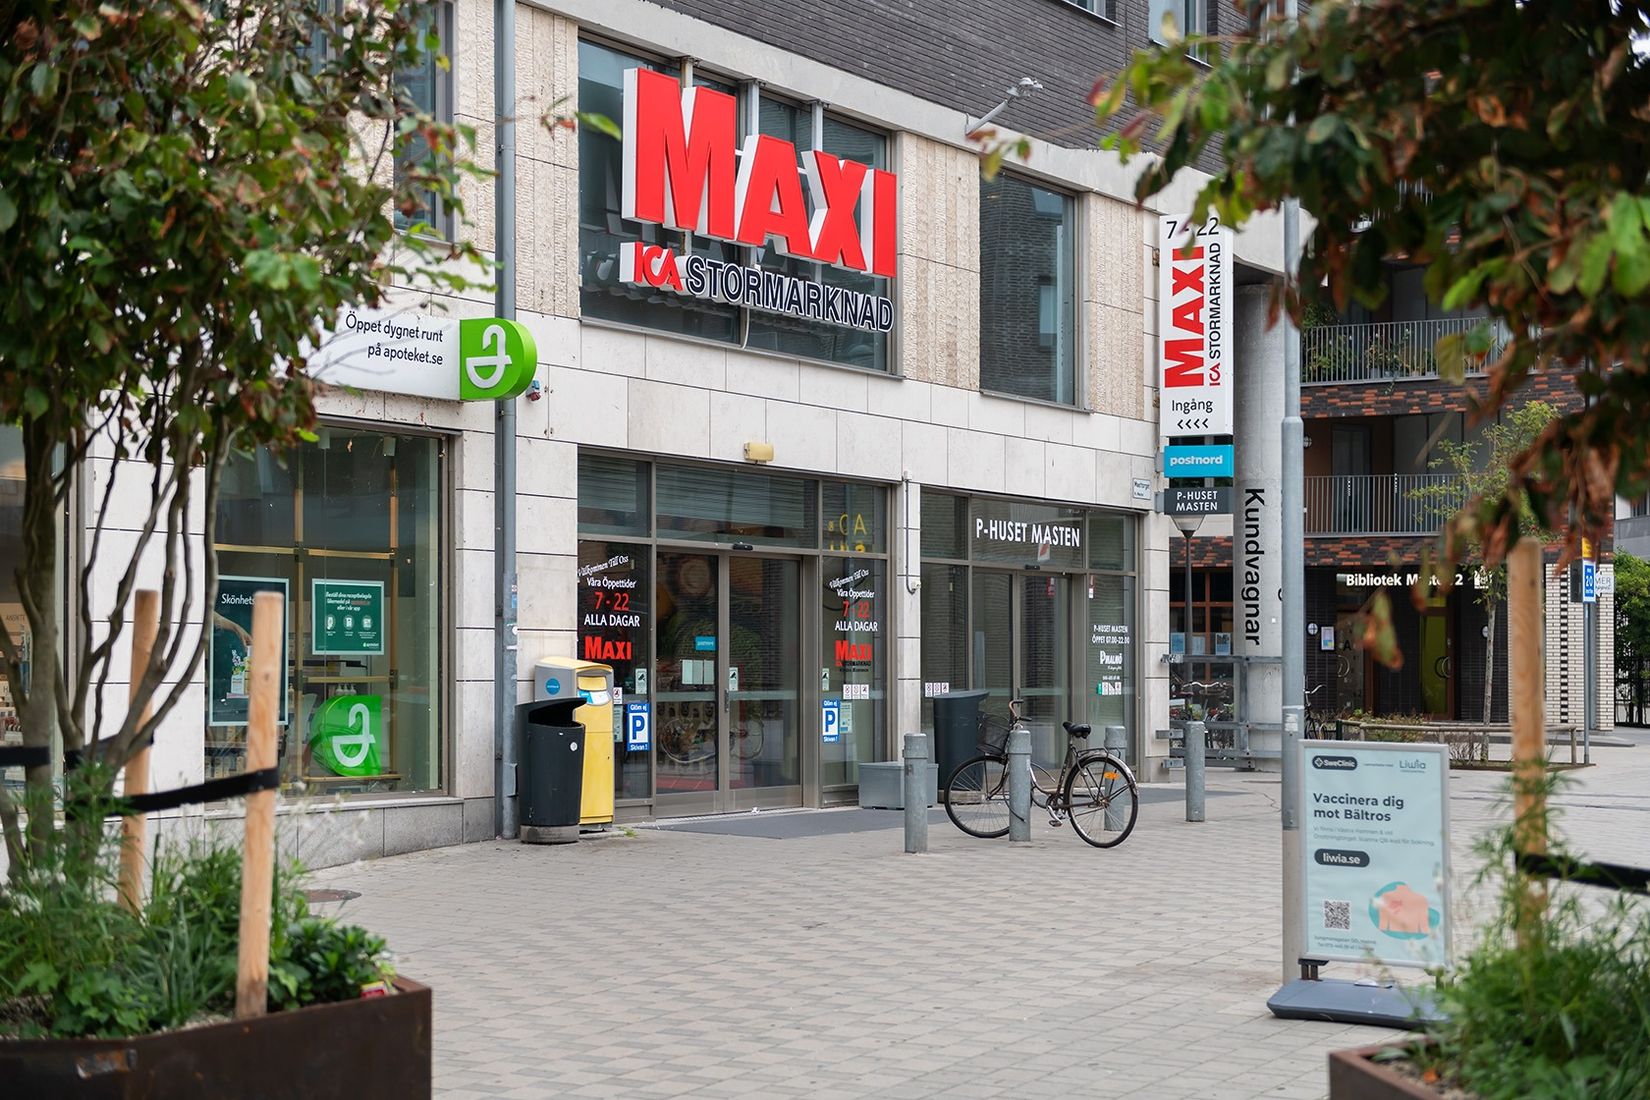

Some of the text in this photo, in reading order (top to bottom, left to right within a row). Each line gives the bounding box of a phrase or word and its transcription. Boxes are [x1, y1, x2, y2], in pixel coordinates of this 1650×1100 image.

[630, 66, 898, 279] MAXI
[630, 241, 894, 333] ICA STORMARKNAD
[1165, 246, 1204, 388] MAXI
[1209, 242, 1221, 386] ICA STORMARKNAD
[345, 310, 443, 342] Öppet dygnet runt
[368, 342, 443, 365] på apoteket.se
[1172, 398, 1213, 414] Ingång
[1170, 455, 1223, 466] postnord
[1176, 490, 1218, 500] P-HUSET
[1175, 502, 1218, 511] MASTEN
[976, 518, 1080, 547] P-HUSET MASTEN
[1241, 488, 1265, 646] Kundvagnar
[587, 576, 636, 589] Våra Öppettider
[1346, 573, 1402, 586] Bibliotek
[1455, 574, 1463, 586] 2
[594, 592, 604, 610] 7
[613, 593, 630, 611] 22
[848, 588, 875, 599] Öppettider
[857, 601, 870, 619] 22
[584, 614, 641, 627] ALLA DAGAR
[835, 621, 878, 631] ALLA DAGAR
[585, 636, 632, 660] MAXI
[834, 640, 872, 661] MAXI
[632, 715, 646, 740] P
[825, 710, 836, 732] P
[1313, 793, 1404, 810] Vaccinera dig
[1314, 808, 1391, 821] mot Bältros
[1322, 852, 1360, 864] liwia.se
